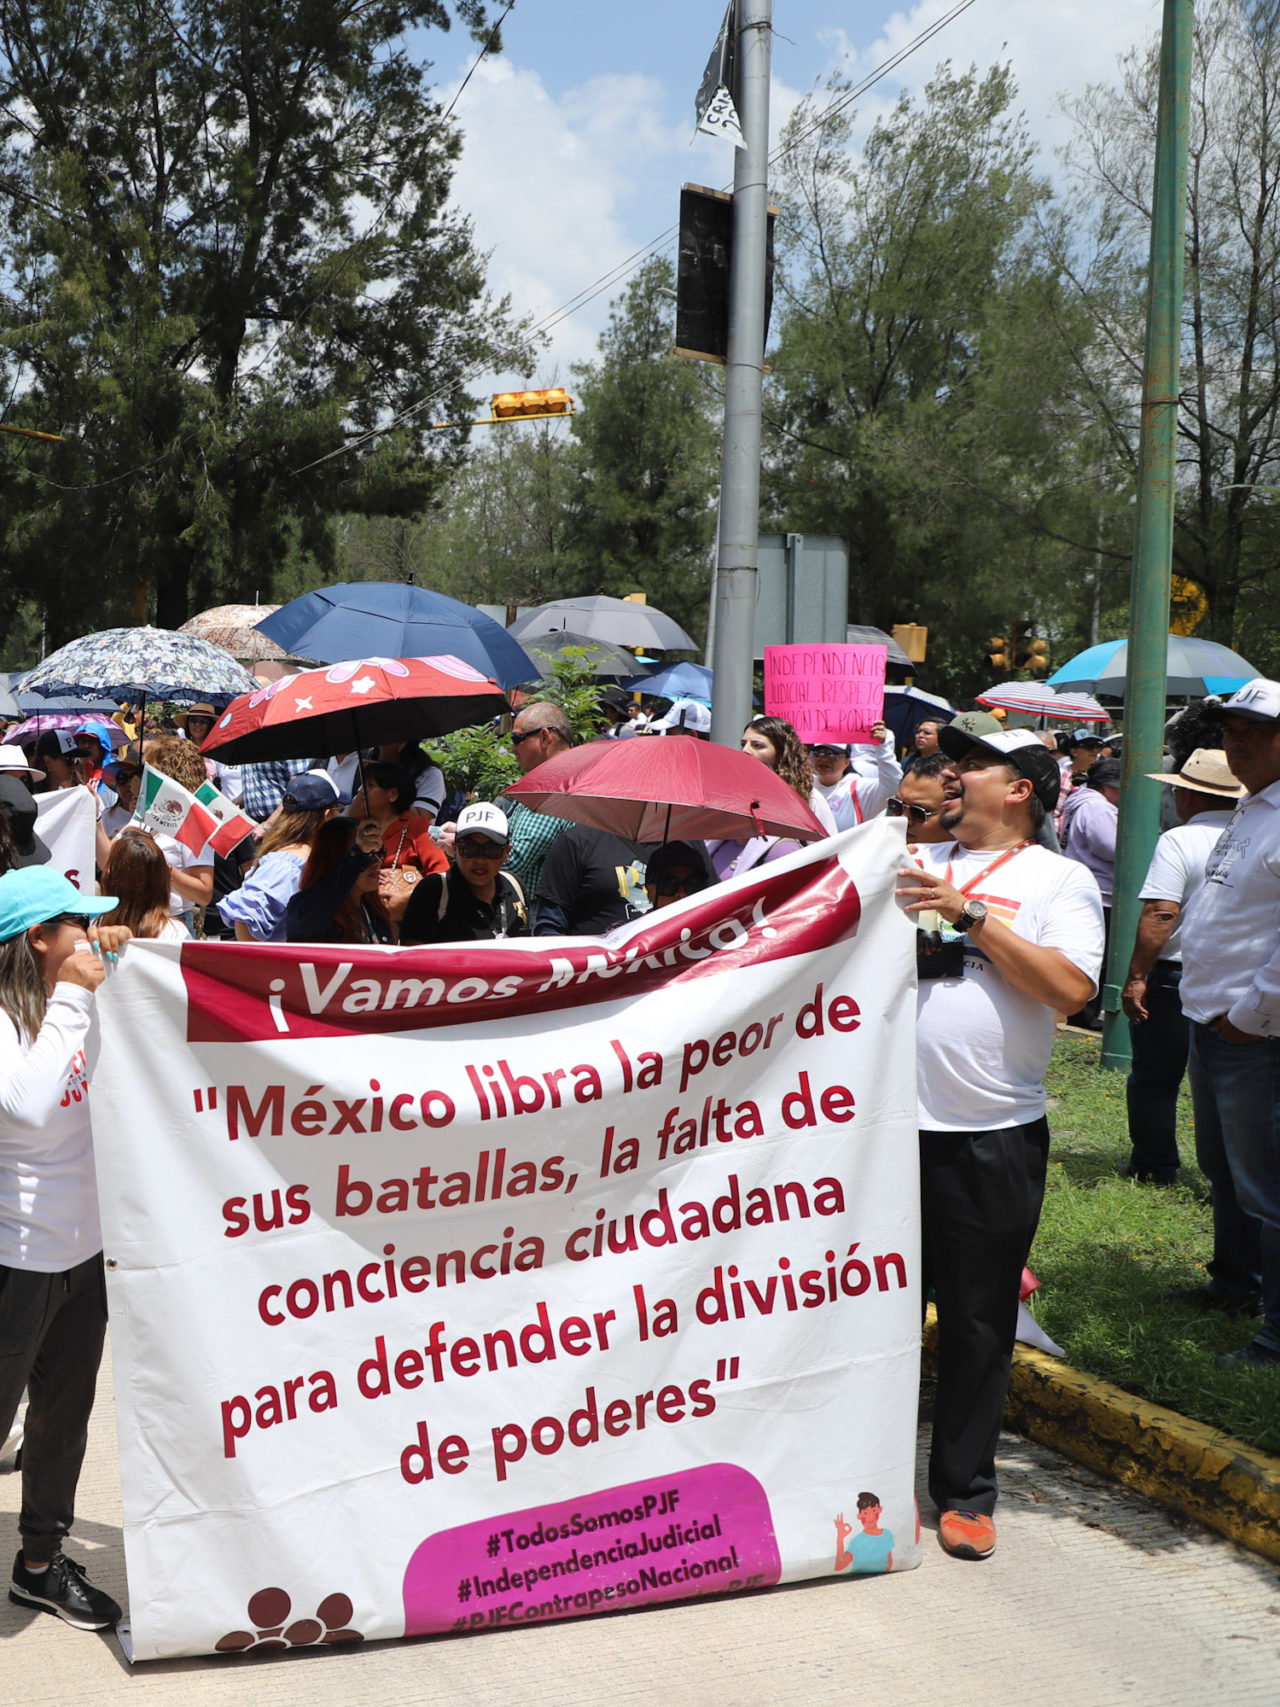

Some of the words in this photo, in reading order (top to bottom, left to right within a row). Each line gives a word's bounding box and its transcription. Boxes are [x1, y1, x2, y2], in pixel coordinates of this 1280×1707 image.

[465, 811, 496, 824] PJF
[268, 962, 524, 1033] ¡Vamos
[193, 1079, 456, 1141] "México
[465, 1060, 603, 1121] libra
[612, 1040, 663, 1093] la
[679, 1014, 784, 1094] peor
[796, 983, 861, 1040] de
[222, 1184, 311, 1238] sus
[335, 1147, 579, 1217] batallas,
[599, 1125, 641, 1178] la
[657, 1095, 765, 1161] falta
[782, 1070, 856, 1130] de
[258, 1226, 545, 1327] conciencia
[565, 1173, 845, 1262] ciudadana
[220, 1370, 338, 1459] para
[357, 1301, 617, 1400] defender
[632, 1284, 678, 1342] la
[695, 1242, 908, 1326] división
[400, 1420, 470, 1485] de
[491, 1356, 740, 1482] poderes"
[458, 1514, 723, 1603] #IndependenciaJudicial
[486, 1489, 681, 1558] #TodosSomosPJF
[451, 1545, 740, 1631] #PJFContrapesoNacional
